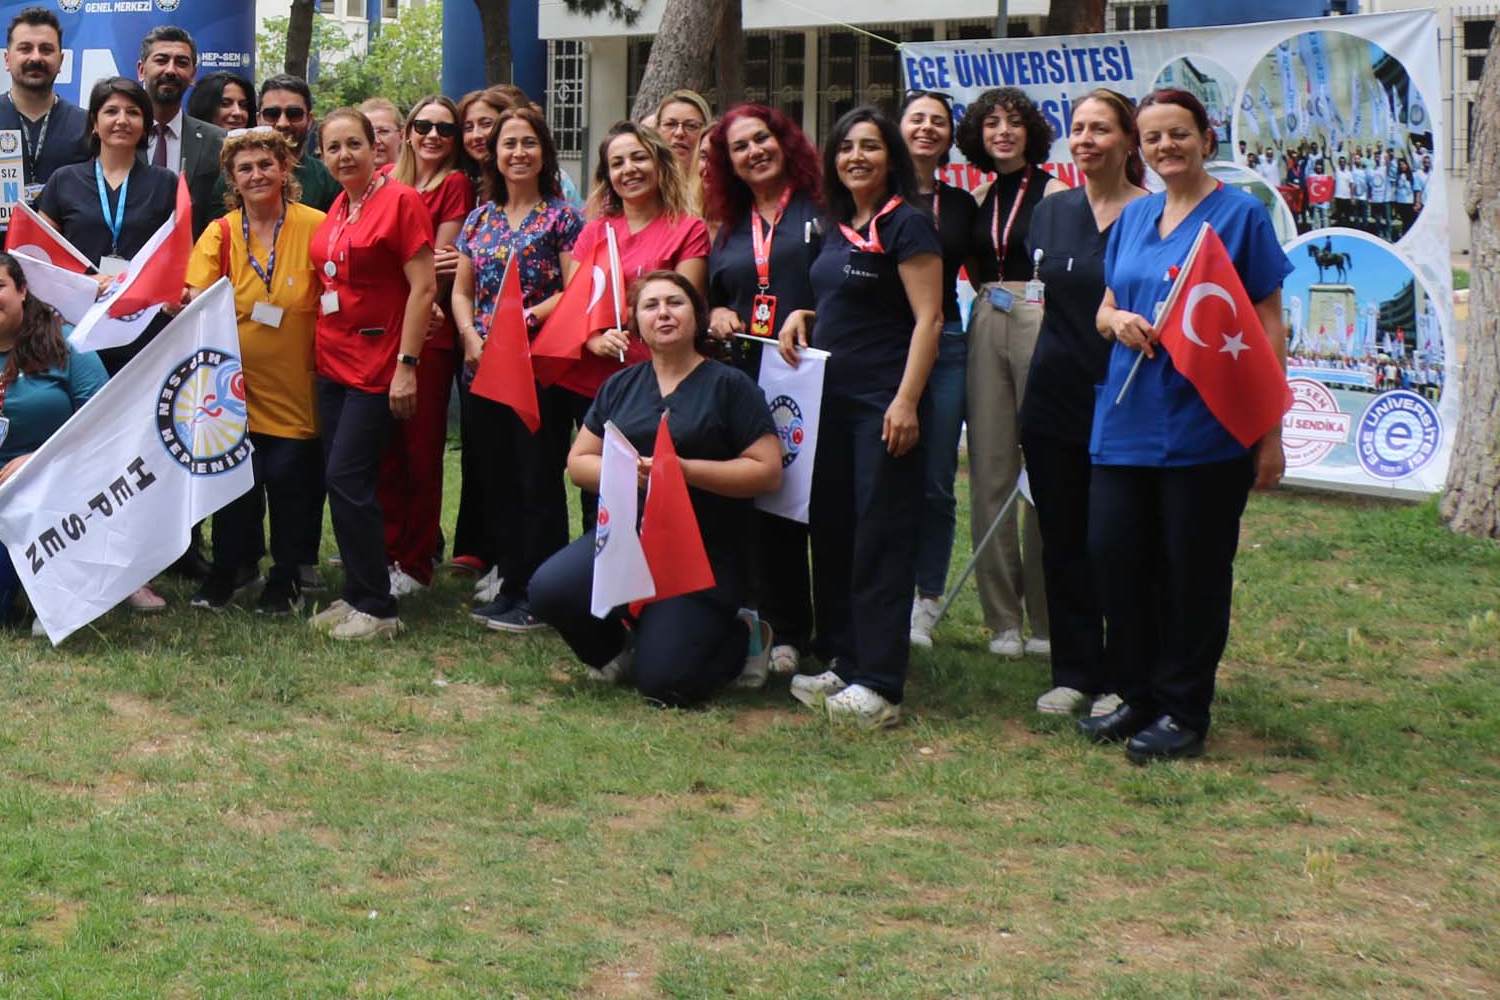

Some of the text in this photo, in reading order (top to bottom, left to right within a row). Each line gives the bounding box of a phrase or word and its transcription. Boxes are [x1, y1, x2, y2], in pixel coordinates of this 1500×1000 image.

[85, 1, 113, 13] GENEL
[202, 52, 241, 61] HEP-SEN
[907, 40, 1134, 89] EGE ÜNİVERSİTESİ
[1295, 418, 1345, 433] SENDİKA
[161, 428, 191, 465] HEP
[25, 456, 157, 575] HEP-SEN
